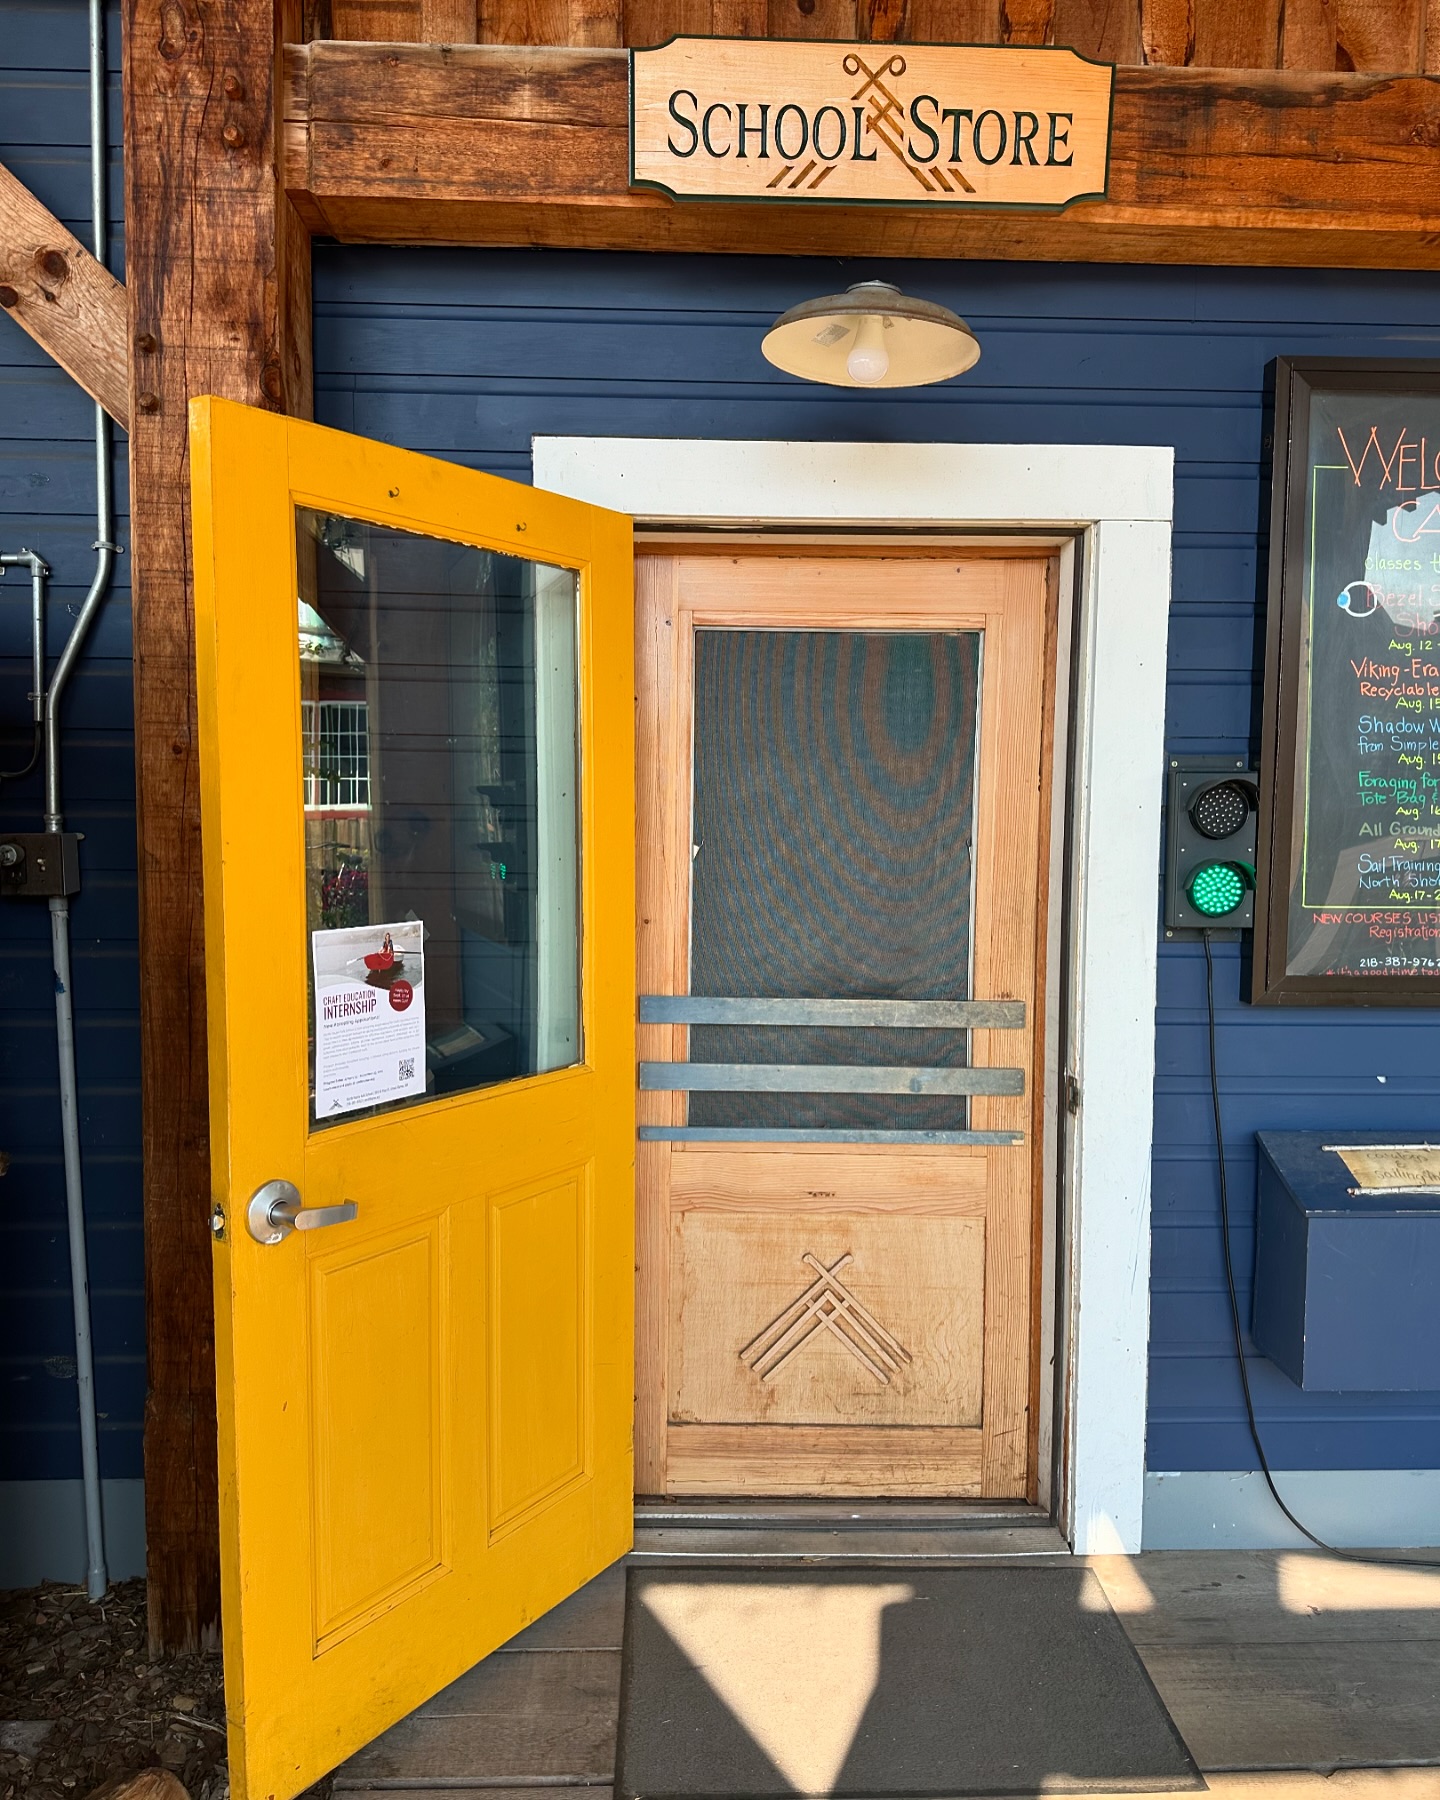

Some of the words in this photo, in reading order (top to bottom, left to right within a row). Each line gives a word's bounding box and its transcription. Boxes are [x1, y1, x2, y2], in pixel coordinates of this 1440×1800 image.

[667, 89, 877, 160] SCHOOL
[907, 94, 1074, 167] STORE
[1365, 551, 1421, 571] classes
[1388, 639, 1415, 657] Aug.
[1420, 640, 1433, 651] 12
[1360, 681, 1440, 701] Recyclable
[1395, 697, 1425, 714] Aug.
[1357, 714, 1425, 734] Shadow
[1390, 735, 1439, 756] Simple
[1398, 753, 1427, 770] Aug.
[1358, 770, 1417, 797] Foraging
[1356, 791, 1387, 806] Tote
[1396, 791, 1426, 809] Bag
[1358, 822, 1382, 836] All
[1389, 821, 1440, 837] Ground
[1394, 838, 1420, 854] Aug.
[1357, 853, 1386, 874] Sail
[1359, 875, 1400, 890] North
[1408, 873, 1440, 888] Sho
[1313, 912, 1343, 924] NEW
[1345, 911, 1412, 924] COURSES
[323, 994, 342, 1006] CRAFT
[343, 989, 376, 1004] EDUCATION
[323, 998, 377, 1021] INTERNSHIP
